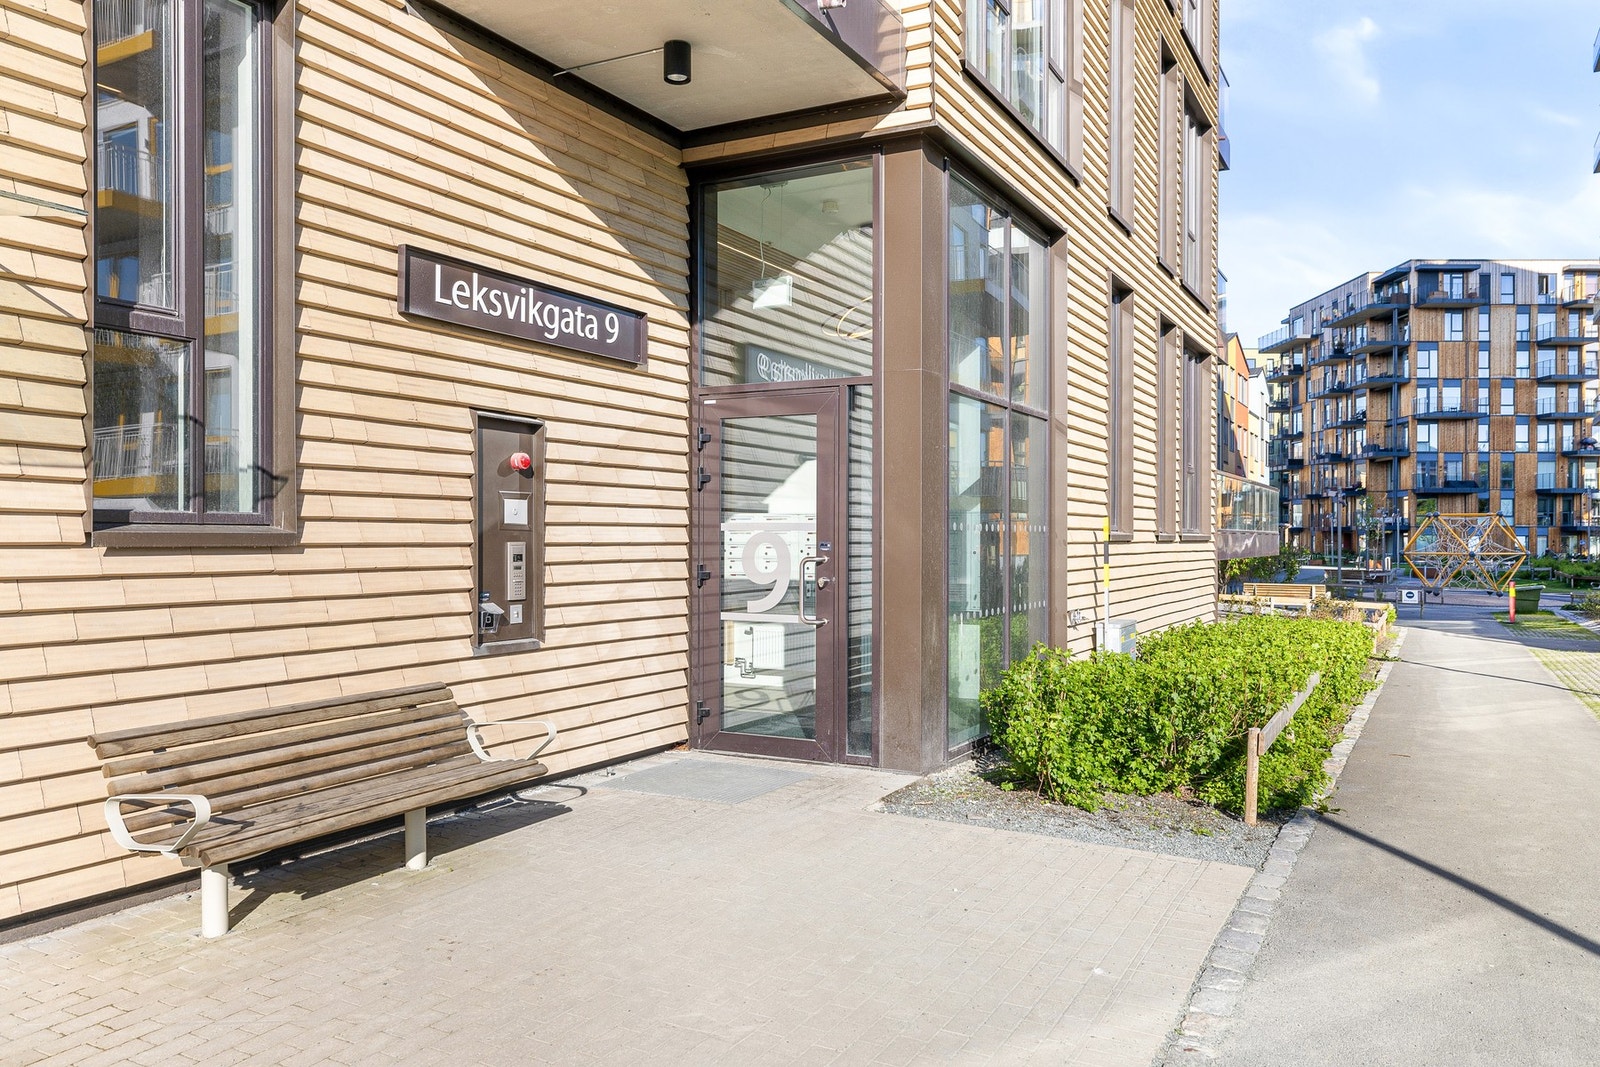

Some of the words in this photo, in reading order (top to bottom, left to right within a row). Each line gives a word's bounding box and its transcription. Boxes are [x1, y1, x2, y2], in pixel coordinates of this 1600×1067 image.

[435, 264, 598, 340] Leksvikgata
[605, 312, 619, 344] 9
[742, 531, 791, 612] 9
